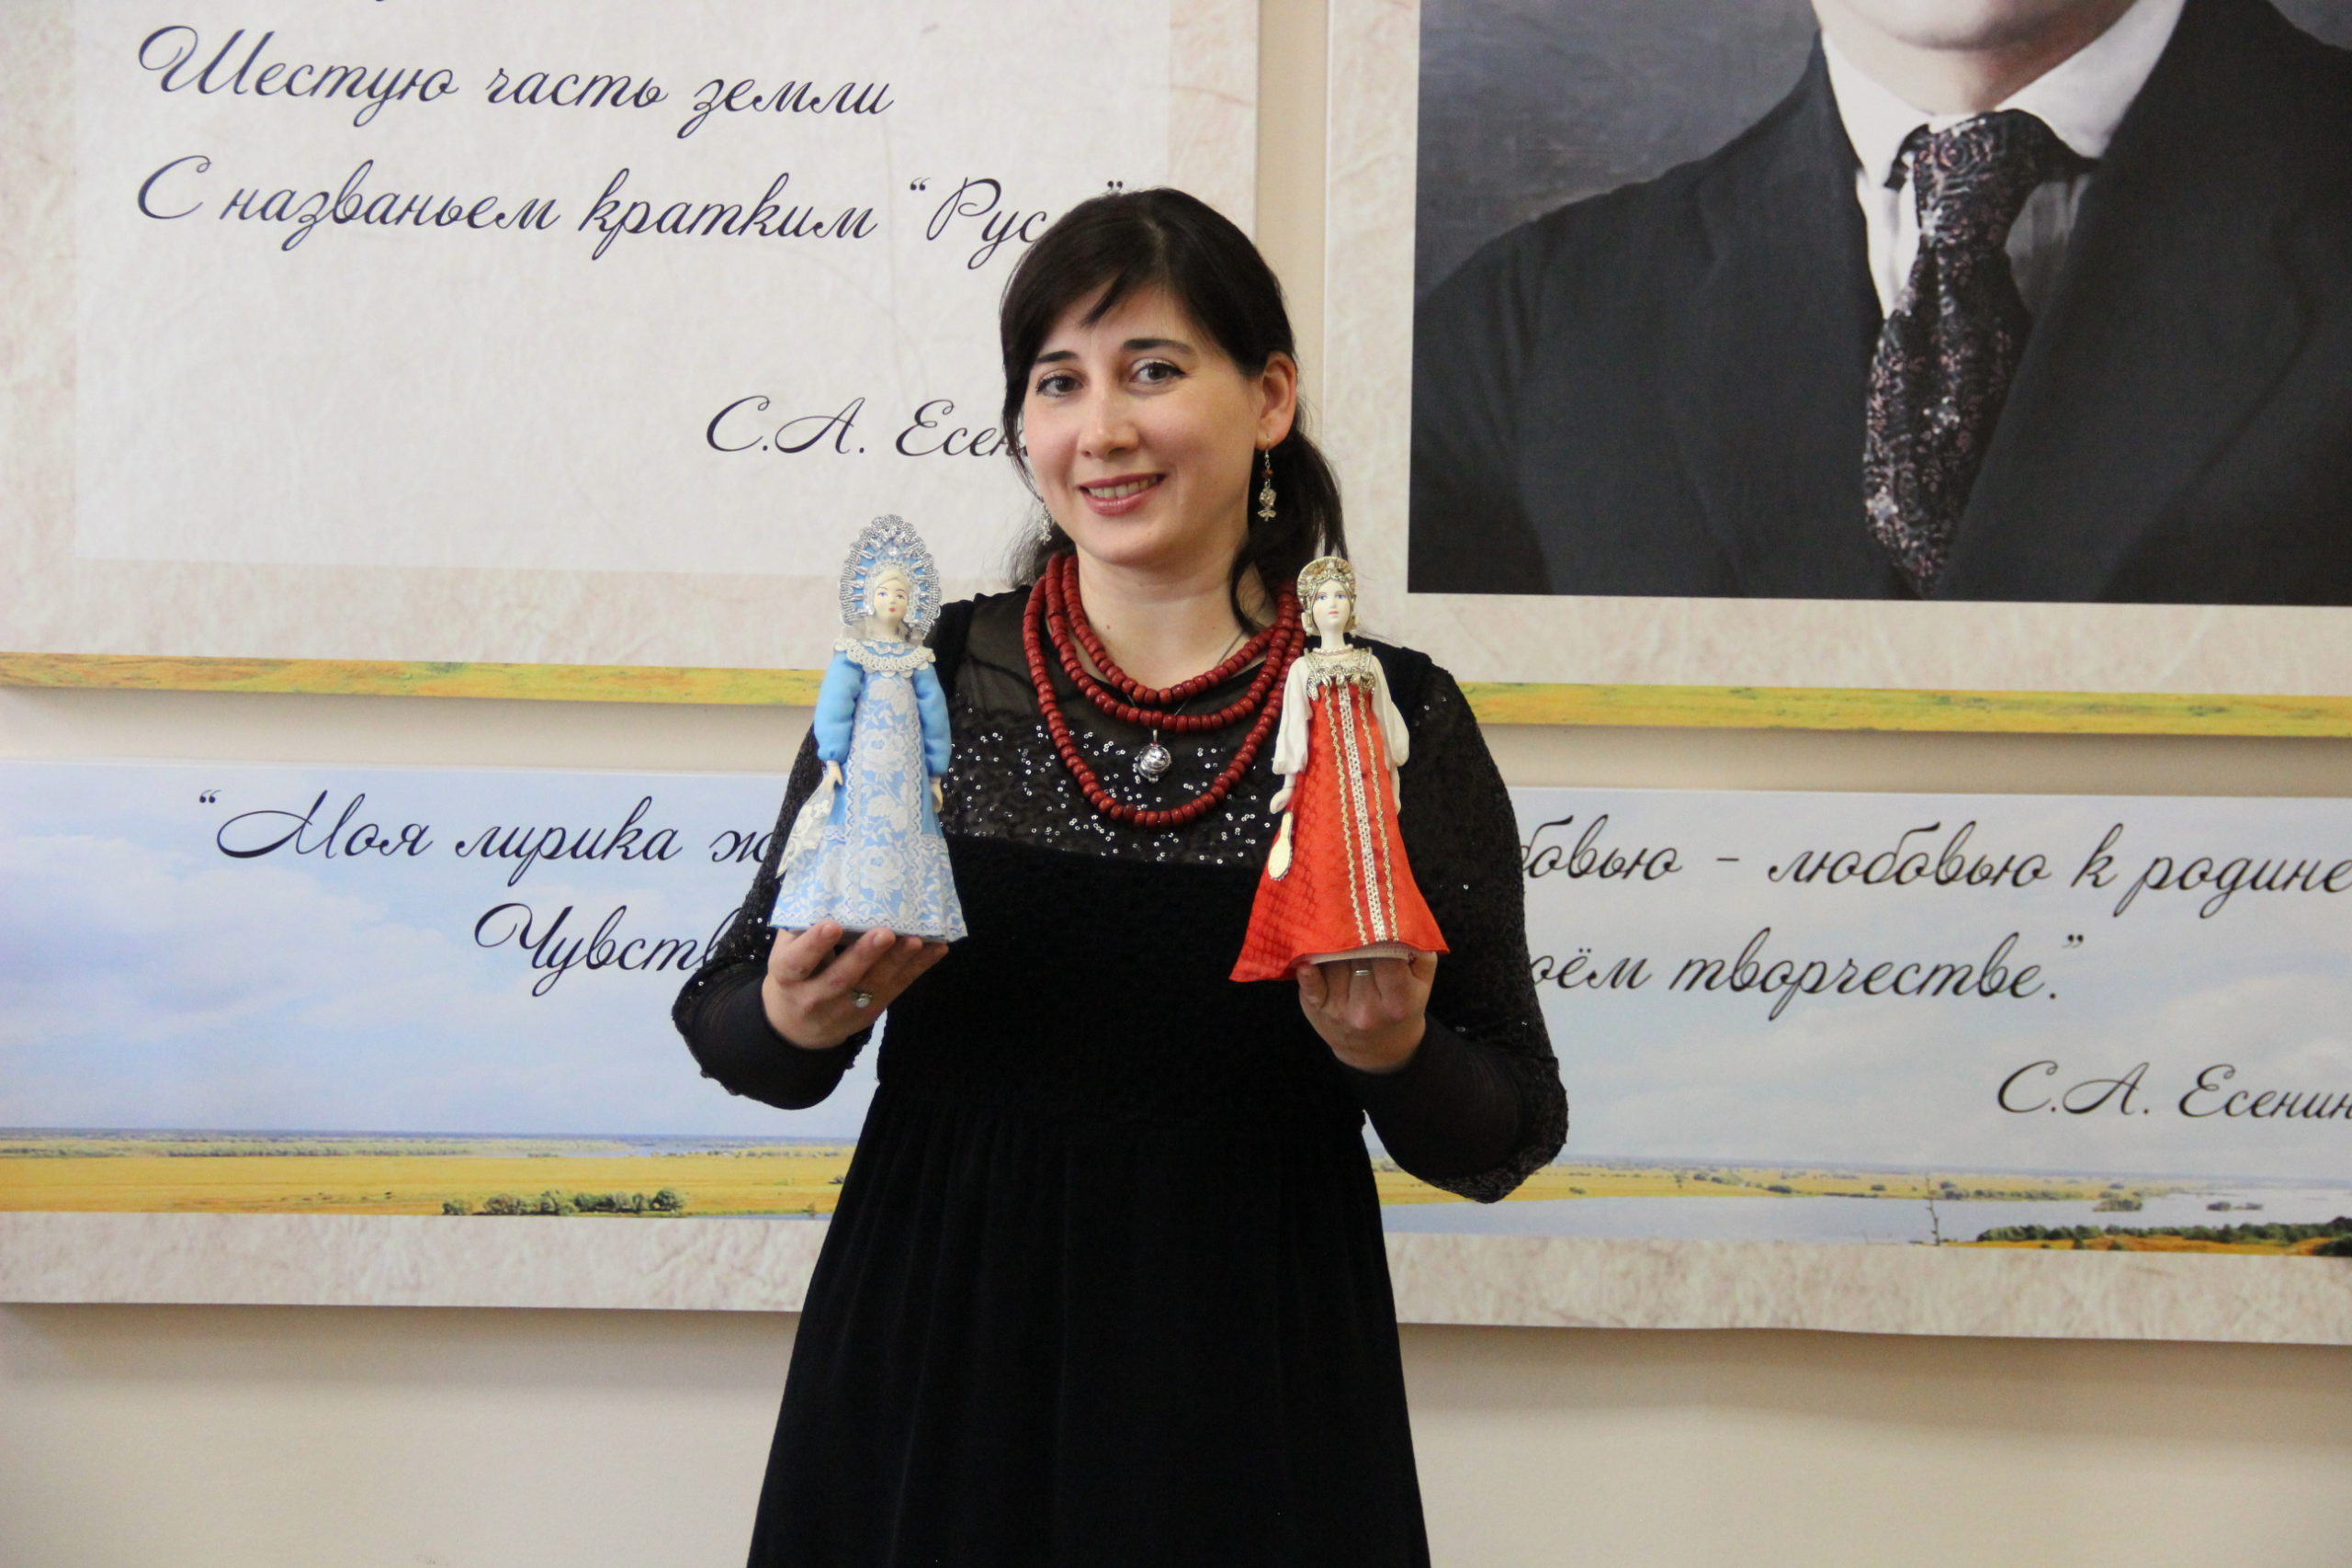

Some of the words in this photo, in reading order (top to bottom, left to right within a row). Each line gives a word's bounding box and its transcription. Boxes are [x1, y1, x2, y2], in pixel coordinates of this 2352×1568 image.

[138, 25, 460, 129] Шестую
[485, 67, 670, 109] часть
[676, 78, 895, 140] земли
[137, 154, 212, 220] С
[218, 158, 561, 253] названьем
[577, 167, 878, 262] кратким
[909, 176, 1125, 272] “Рус”
[895, 396, 1030, 459] Есен
[454, 795, 684, 888] лирика
[1520, 813, 1683, 882] бовью
[1767, 819, 2052, 888] любовью
[2069, 822, 2121, 889] к
[2113, 854, 2352, 919] родине
[473, 902, 742, 998] Чувст
[1529, 947, 1653, 993] оём
